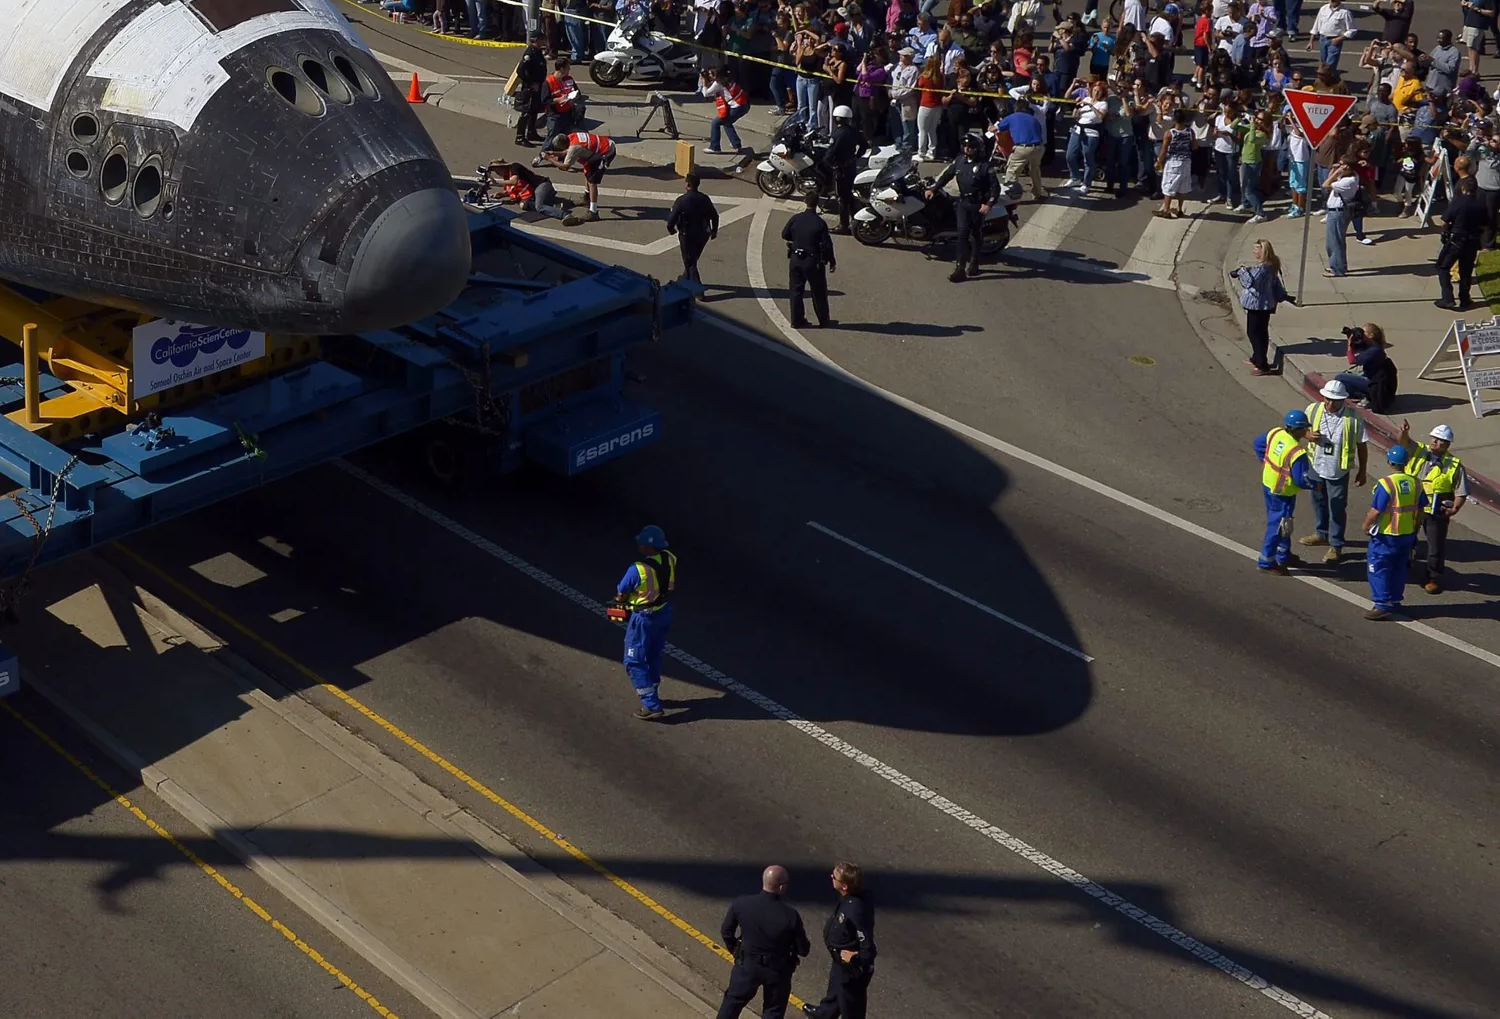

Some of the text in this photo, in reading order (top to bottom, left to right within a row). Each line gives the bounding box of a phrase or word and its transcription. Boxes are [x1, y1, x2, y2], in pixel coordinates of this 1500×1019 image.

[1307, 107, 1329, 115] YIELD
[150, 350, 252, 391] Samuel Oschin Air and Space Center
[586, 423, 654, 461] sarens
